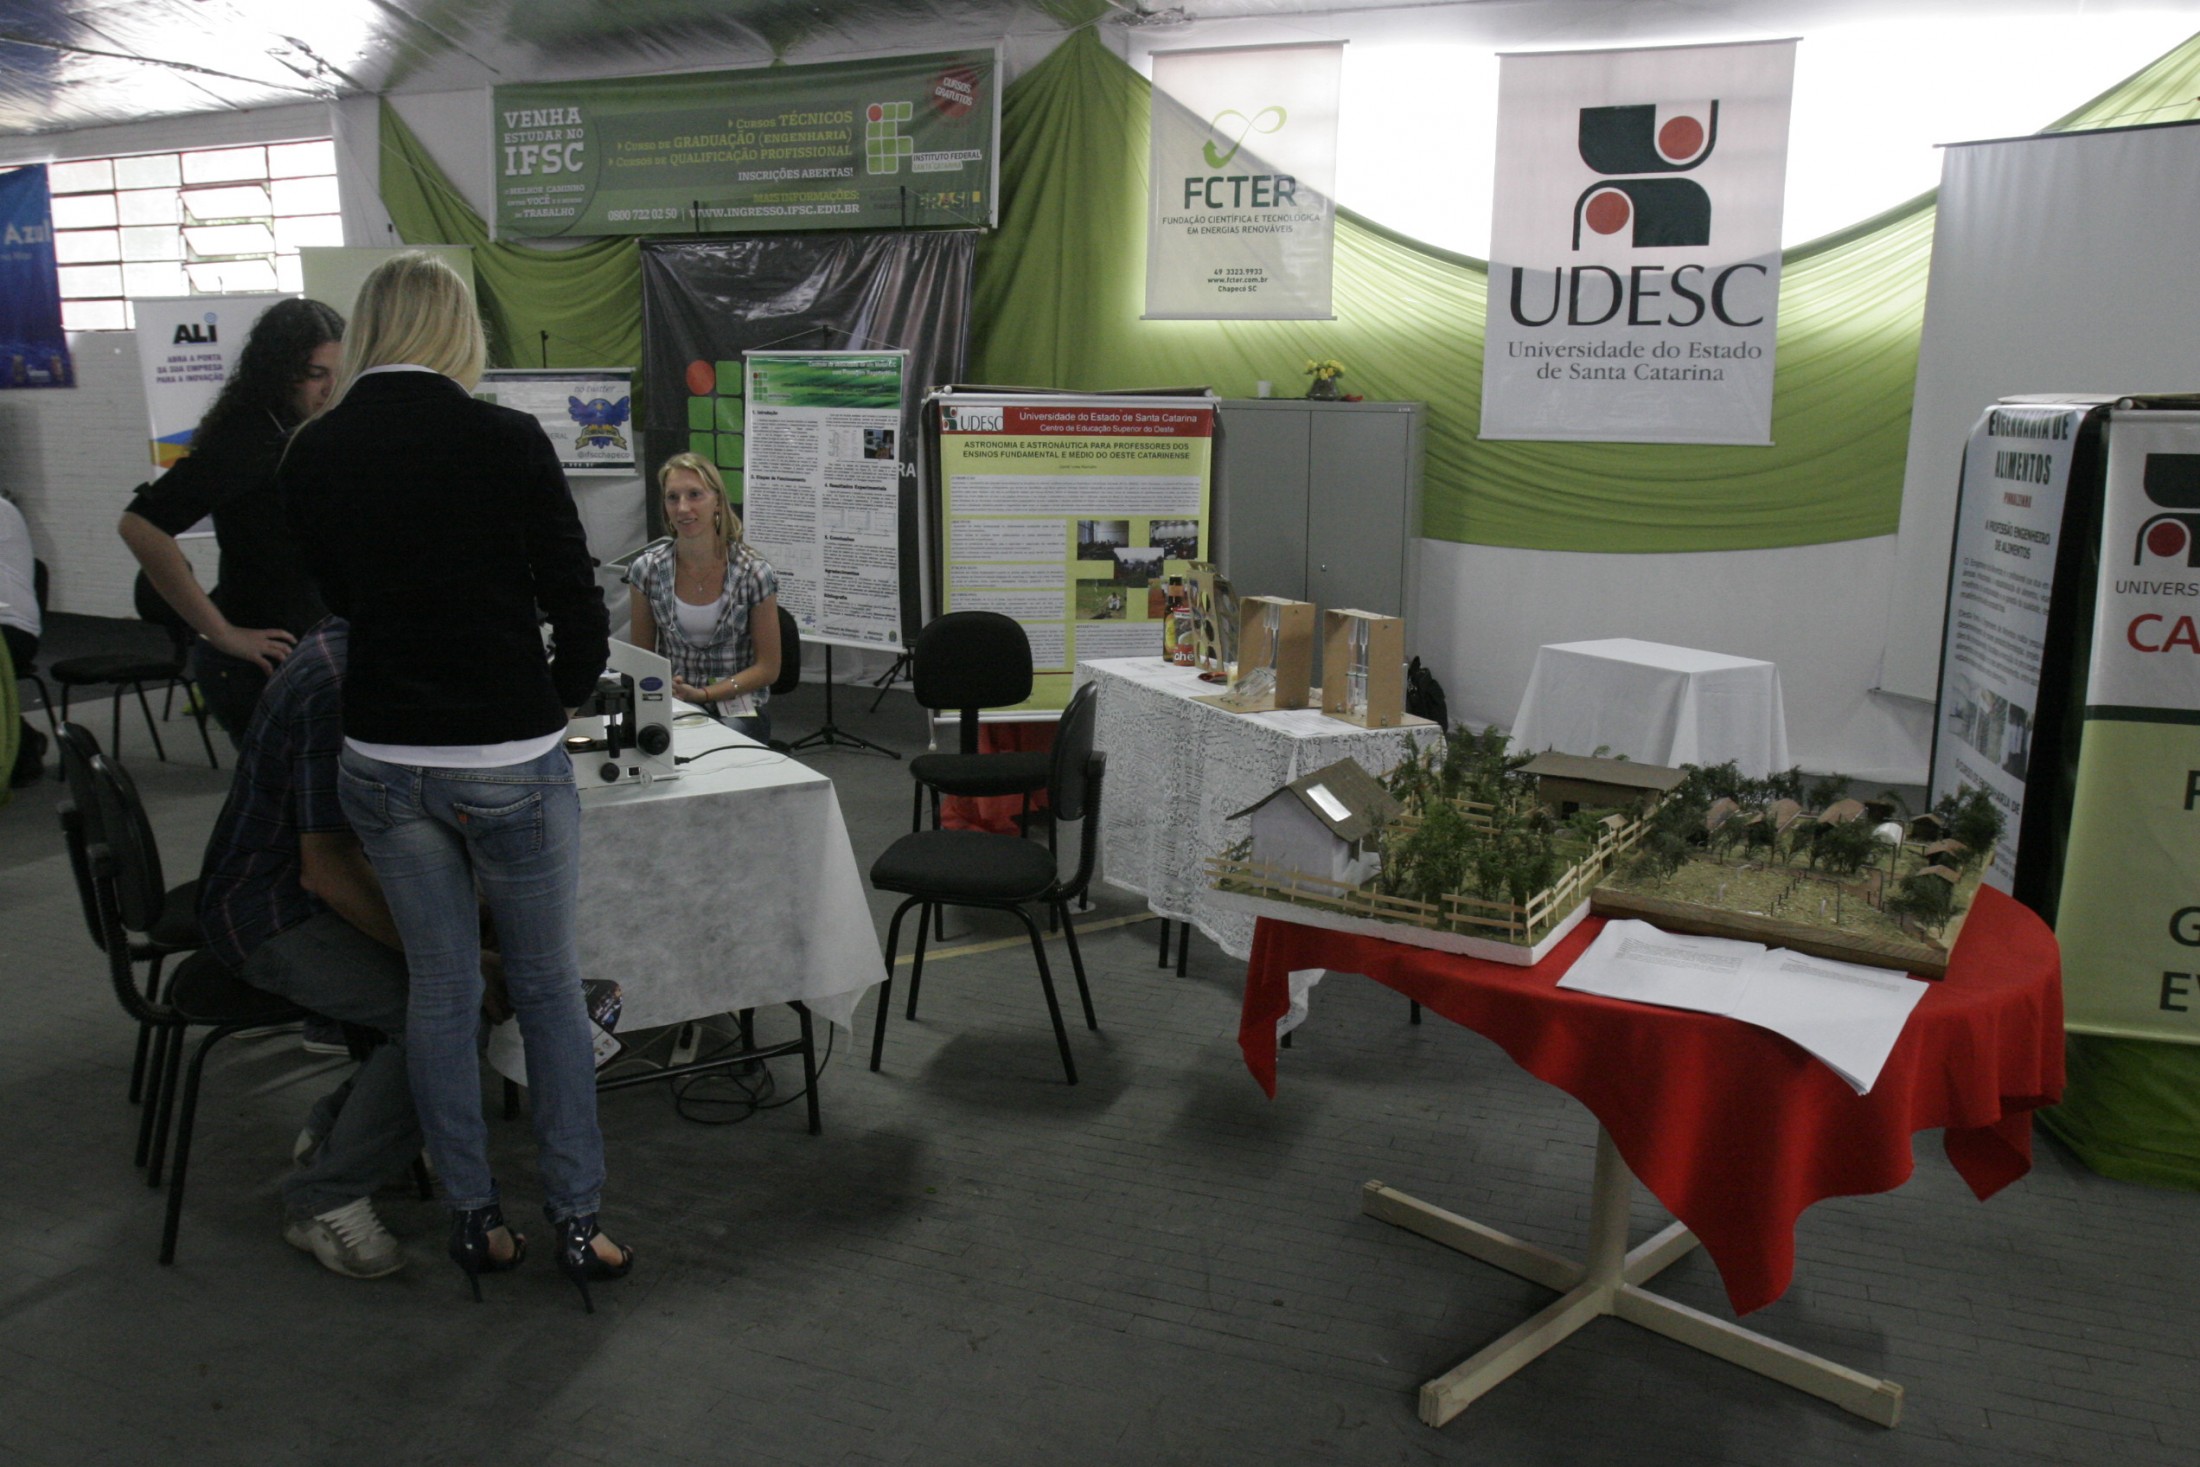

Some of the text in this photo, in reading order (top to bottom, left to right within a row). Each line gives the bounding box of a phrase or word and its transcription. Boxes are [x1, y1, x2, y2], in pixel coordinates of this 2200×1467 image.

[943, 77, 972, 94] CURSOS
[935, 86, 974, 106] GRATUITOS
[503, 106, 583, 129] VENHA
[778, 110, 853, 127] TÉCNICOS
[503, 128, 584, 143] ESTUDAR NO
[673, 129, 755, 150] GRADUAÇÃO
[758, 127, 852, 147] (ENGENHARIA)
[504, 142, 585, 176] IFSC
[670, 148, 758, 167] QUALIFICAÇÃO
[760, 145, 853, 160] PROFISSIONAL
[913, 151, 981, 162] INSTITUTO FEDERAL
[738, 167, 854, 182] INSCRIÇÕES ABERTAS!
[1184, 174, 1297, 210] FCTER
[523, 207, 575, 218] TRABALHO
[608, 209, 630, 221] 0800
[631, 209, 650, 220] 722
[651, 208, 664, 220] 02
[665, 208, 678, 220] 50
[1162, 213, 1320, 225] FUNDAÇÃO CIENTÍFICA E TECNOLÓGICA
[1187, 224, 1293, 235] EM ENERGIAS RENOVÁVEIS
[1207, 276, 1268, 284] www.fcter.com.br
[1214, 268, 1223, 276] 49
[1248, 285, 1257, 293] SC
[1509, 263, 1768, 328] UDESC
[1507, 340, 1763, 360] Universidade do Estado
[1536, 362, 1725, 382] de Santa Catarina
[960, 415, 1004, 431] UDESC
[1019, 411, 1198, 423] Universidade do Estado de Santa Catarina
[1040, 423, 1175, 434] Centro de Educação Superior do Oeste
[964, 440, 1190, 450] ASTRONOMIA E ASTRONÁUTICA PARA PROFESSORES DOS
[963, 450, 999, 459] ENSINOS
[1000, 450, 1059, 459] FUNDAMENTAL
[1061, 451, 1067, 459] E
[1095, 451, 1108, 459] DO
[1109, 451, 1136, 459] OESTE
[1137, 451, 1190, 460] CATARINENSE
[1995, 450, 2053, 486] ALIMENTOS
[2115, 580, 2200, 597] UNIVERS
[2126, 612, 2200, 655] CA
